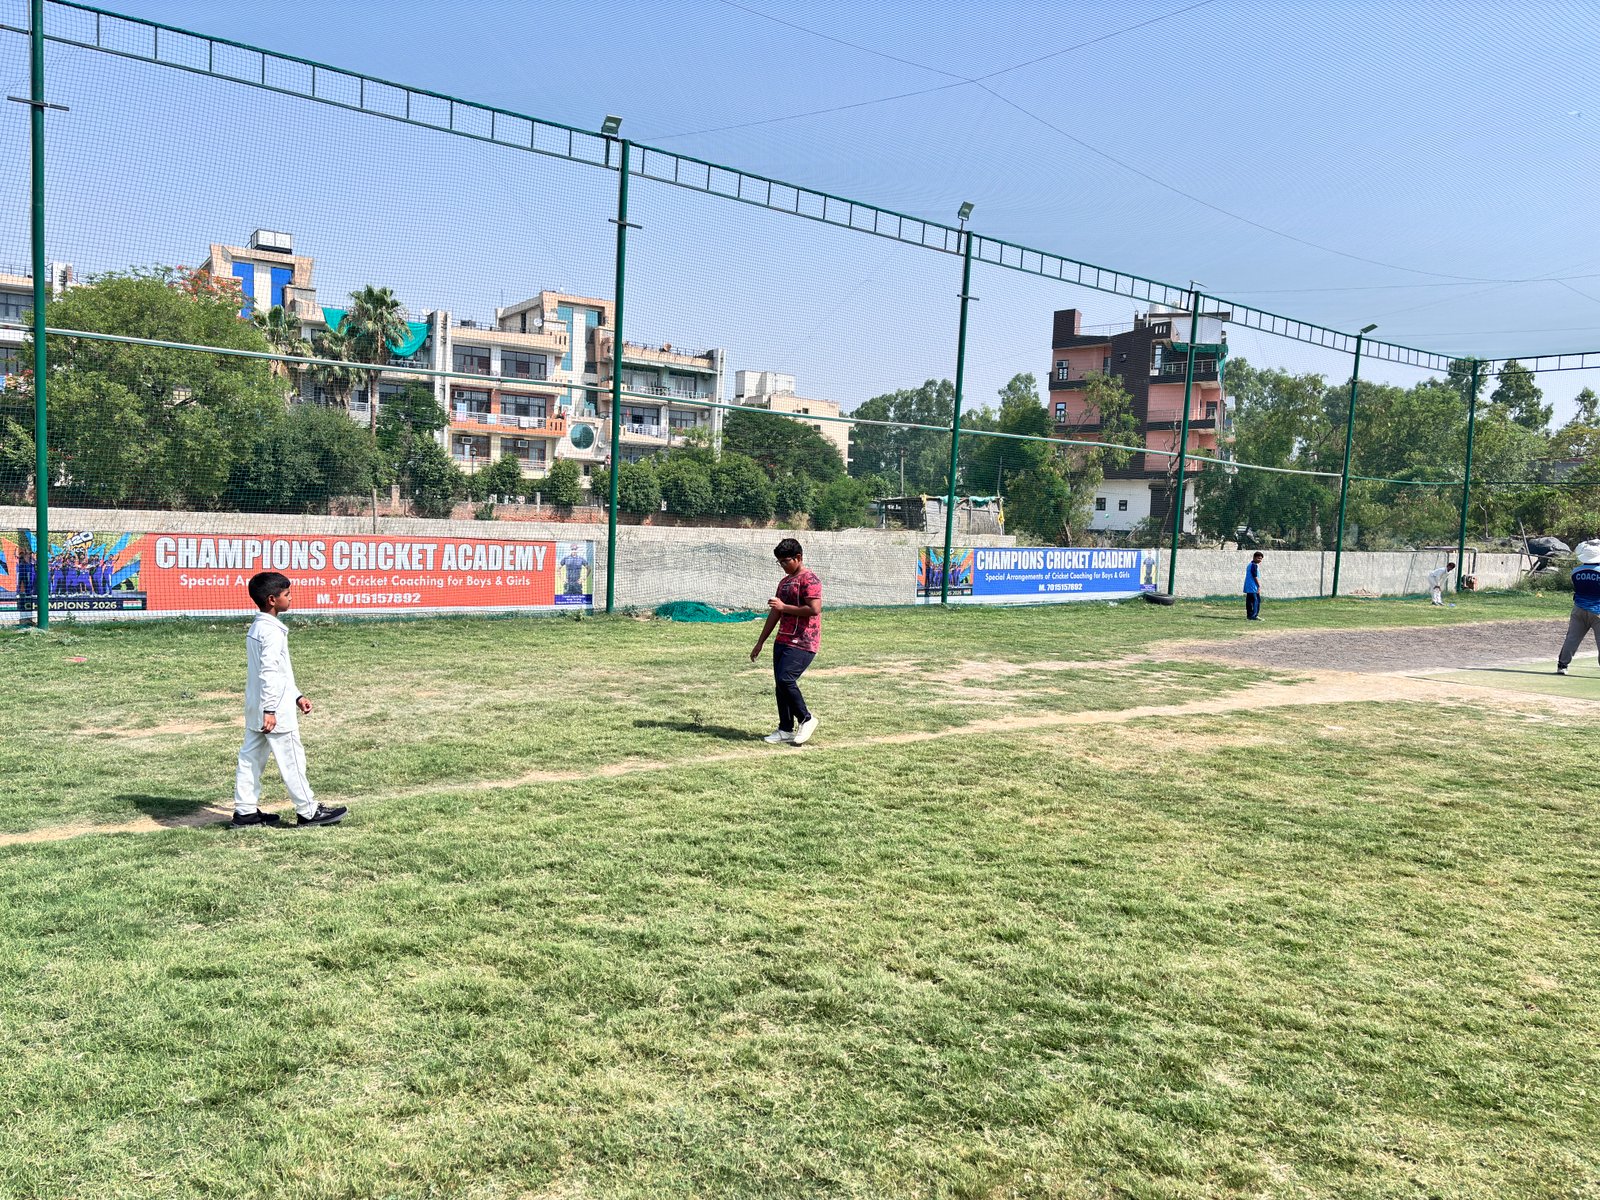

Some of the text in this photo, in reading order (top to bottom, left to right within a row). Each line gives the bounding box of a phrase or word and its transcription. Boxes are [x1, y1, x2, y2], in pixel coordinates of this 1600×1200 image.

[155, 537, 547, 571] CHAMPIONS CRICKET ACADEMY
[976, 550, 1138, 570] CHAMPIONS CRICKET ACADEMY
[180, 574, 531, 589] Special Arments of Cricket Coaching for Boys & Girls
[985, 573, 1006, 582] Special
[1007, 573, 1043, 582] Arrangements
[1044, 572, 1051, 580] of
[1051, 572, 1069, 580] Cricket
[1070, 572, 1093, 580] Coaching
[1102, 572, 1114, 580] Boys
[1118, 571, 1130, 579] Girls
[1038, 584, 1046, 592] M.
[316, 593, 421, 604] M. 7015157892
[24, 601, 118, 610] CHMPIONS 2026
